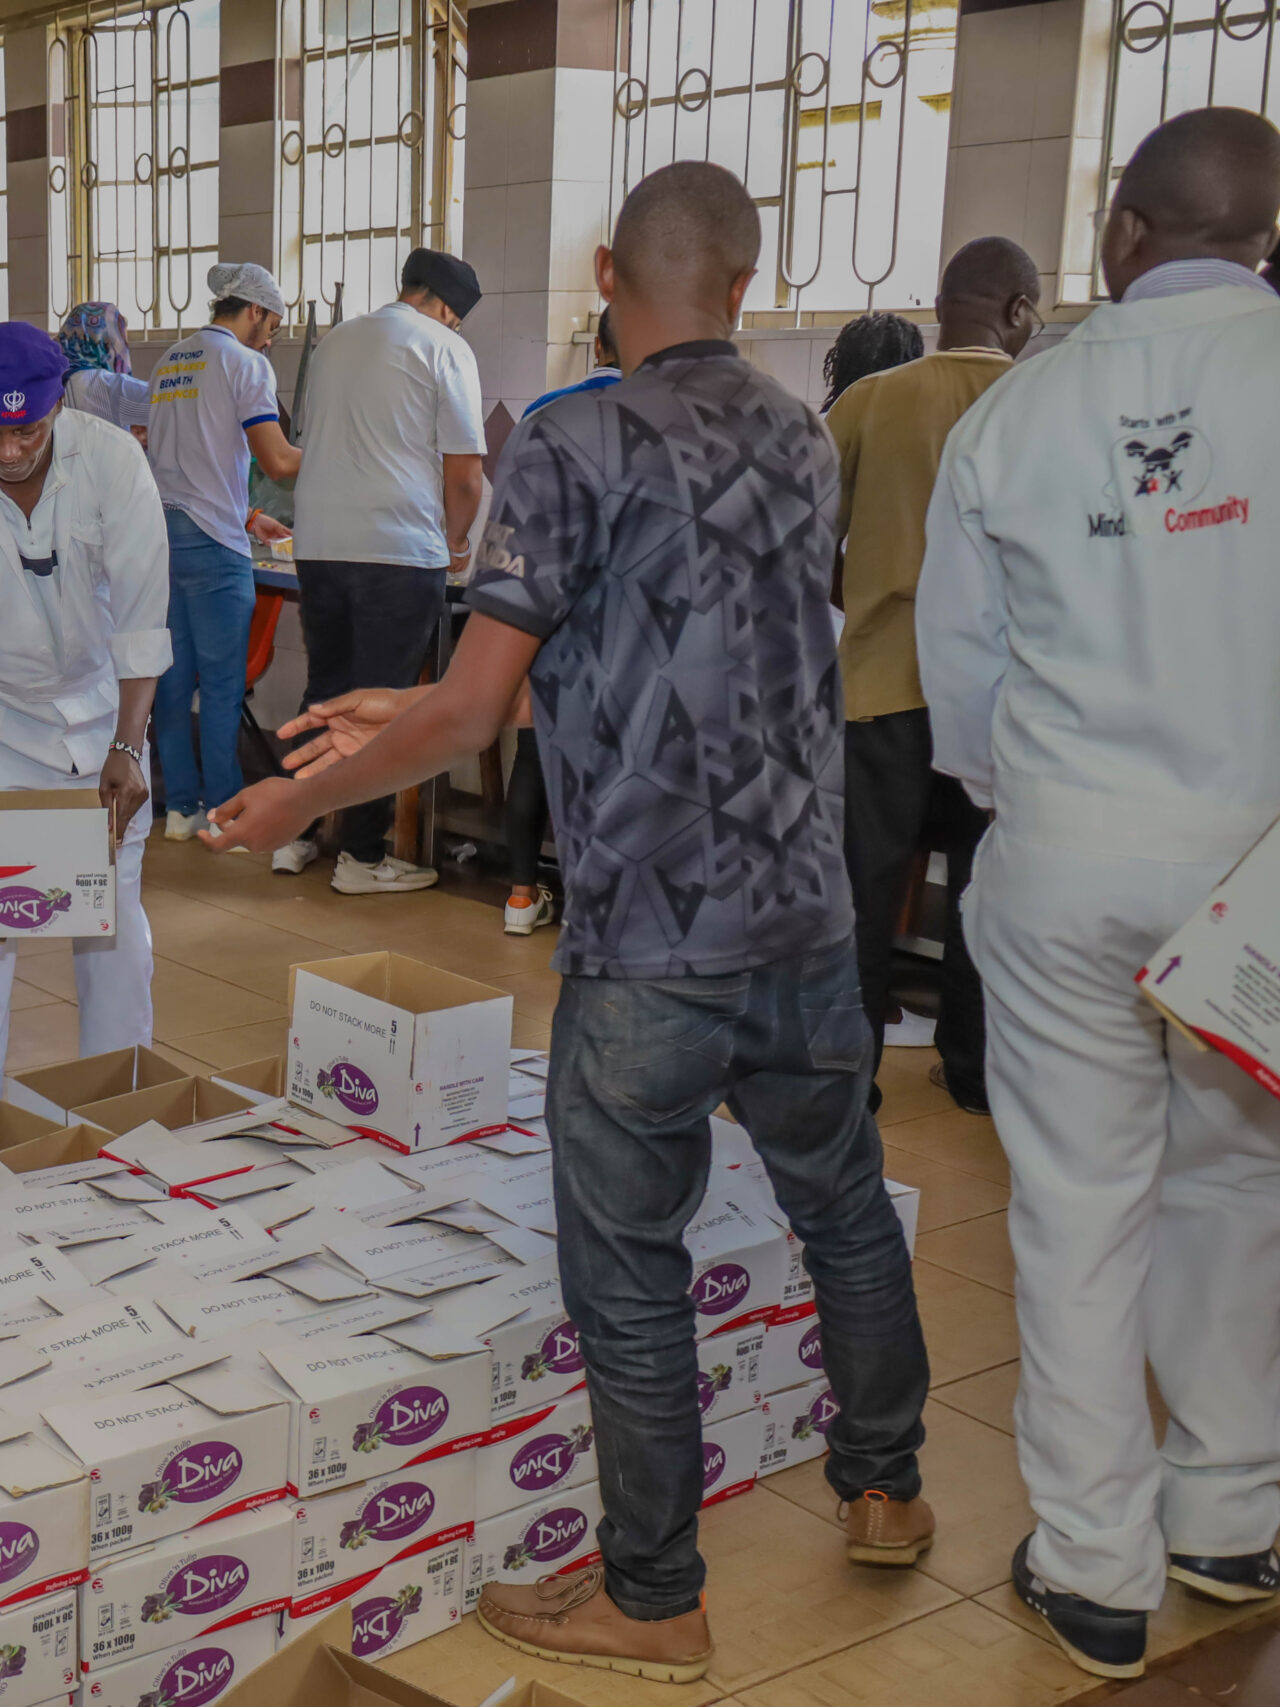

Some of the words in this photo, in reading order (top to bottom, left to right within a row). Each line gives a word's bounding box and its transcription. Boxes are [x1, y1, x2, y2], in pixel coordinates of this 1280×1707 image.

[170, 350, 204, 361] BEYOND
[1088, 511, 1125, 538] Mind
[1164, 496, 1249, 533] Community
[309, 1000, 321, 1011] DO
[322, 1004, 338, 1019] NOT
[338, 1010, 363, 1029] STACK
[363, 1020, 388, 1038] MORE
[390, 1019, 398, 1034] 5
[302, 1087, 314, 1100] 100g
[340, 1068, 377, 1102] Diva
[15, 1205, 32, 1213] DO
[34, 1200, 58, 1210] NOT
[61, 1196, 96, 1206] STACK
[706, 1212, 737, 1230] MORE
[726, 1201, 740, 1212] 5
[151, 1236, 189, 1252] STACK
[188, 1228, 223, 1243] MORE
[218, 1217, 232, 1228] 5
[365, 1246, 383, 1256] DO
[383, 1241, 405, 1251] NOT
[405, 1233, 440, 1246] STACK
[0, 1268, 36, 1286] MORE
[30, 1256, 44, 1267] 5
[518, 1280, 556, 1298] STACK
[702, 1273, 747, 1302] Diva
[201, 1304, 221, 1315] DO
[221, 1298, 247, 1310] NOT
[247, 1291, 286, 1304] STACK
[50, 1334, 92, 1352] STACK
[91, 1319, 131, 1337] MORE
[124, 1305, 138, 1317] 5
[137, 1359, 164, 1372] NOT
[163, 1352, 185, 1362] DO
[306, 1361, 326, 1373] DO
[327, 1356, 352, 1368] NOT
[352, 1349, 389, 1363] STACK
[93, 1367, 136, 1388] STACK
[94, 1418, 116, 1430] DO
[116, 1411, 145, 1426] NOT
[145, 1402, 189, 1418] STACK
[389, 1396, 446, 1432] Diva
[174, 1439, 191, 1453] Tulip
[177, 1450, 238, 1489] Diva
[513, 1447, 563, 1482] Diva
[375, 1491, 431, 1528] Diva
[90, 1532, 103, 1544] 36
[111, 1524, 133, 1538] 100g
[90, 1541, 109, 1553] When
[109, 1535, 132, 1548] packed
[535, 1515, 584, 1550] Diva
[179, 1552, 198, 1567] Tulip
[297, 1569, 309, 1581] 36
[315, 1560, 335, 1574] 100g
[182, 1564, 245, 1601] Diva
[32, 1618, 55, 1633] 100g
[62, 1611, 74, 1622] 36
[92, 1649, 111, 1661] When
[111, 1643, 134, 1658] packed
[93, 1641, 105, 1653] 36
[114, 1632, 135, 1647] 100g
[174, 1655, 230, 1697] Diva
